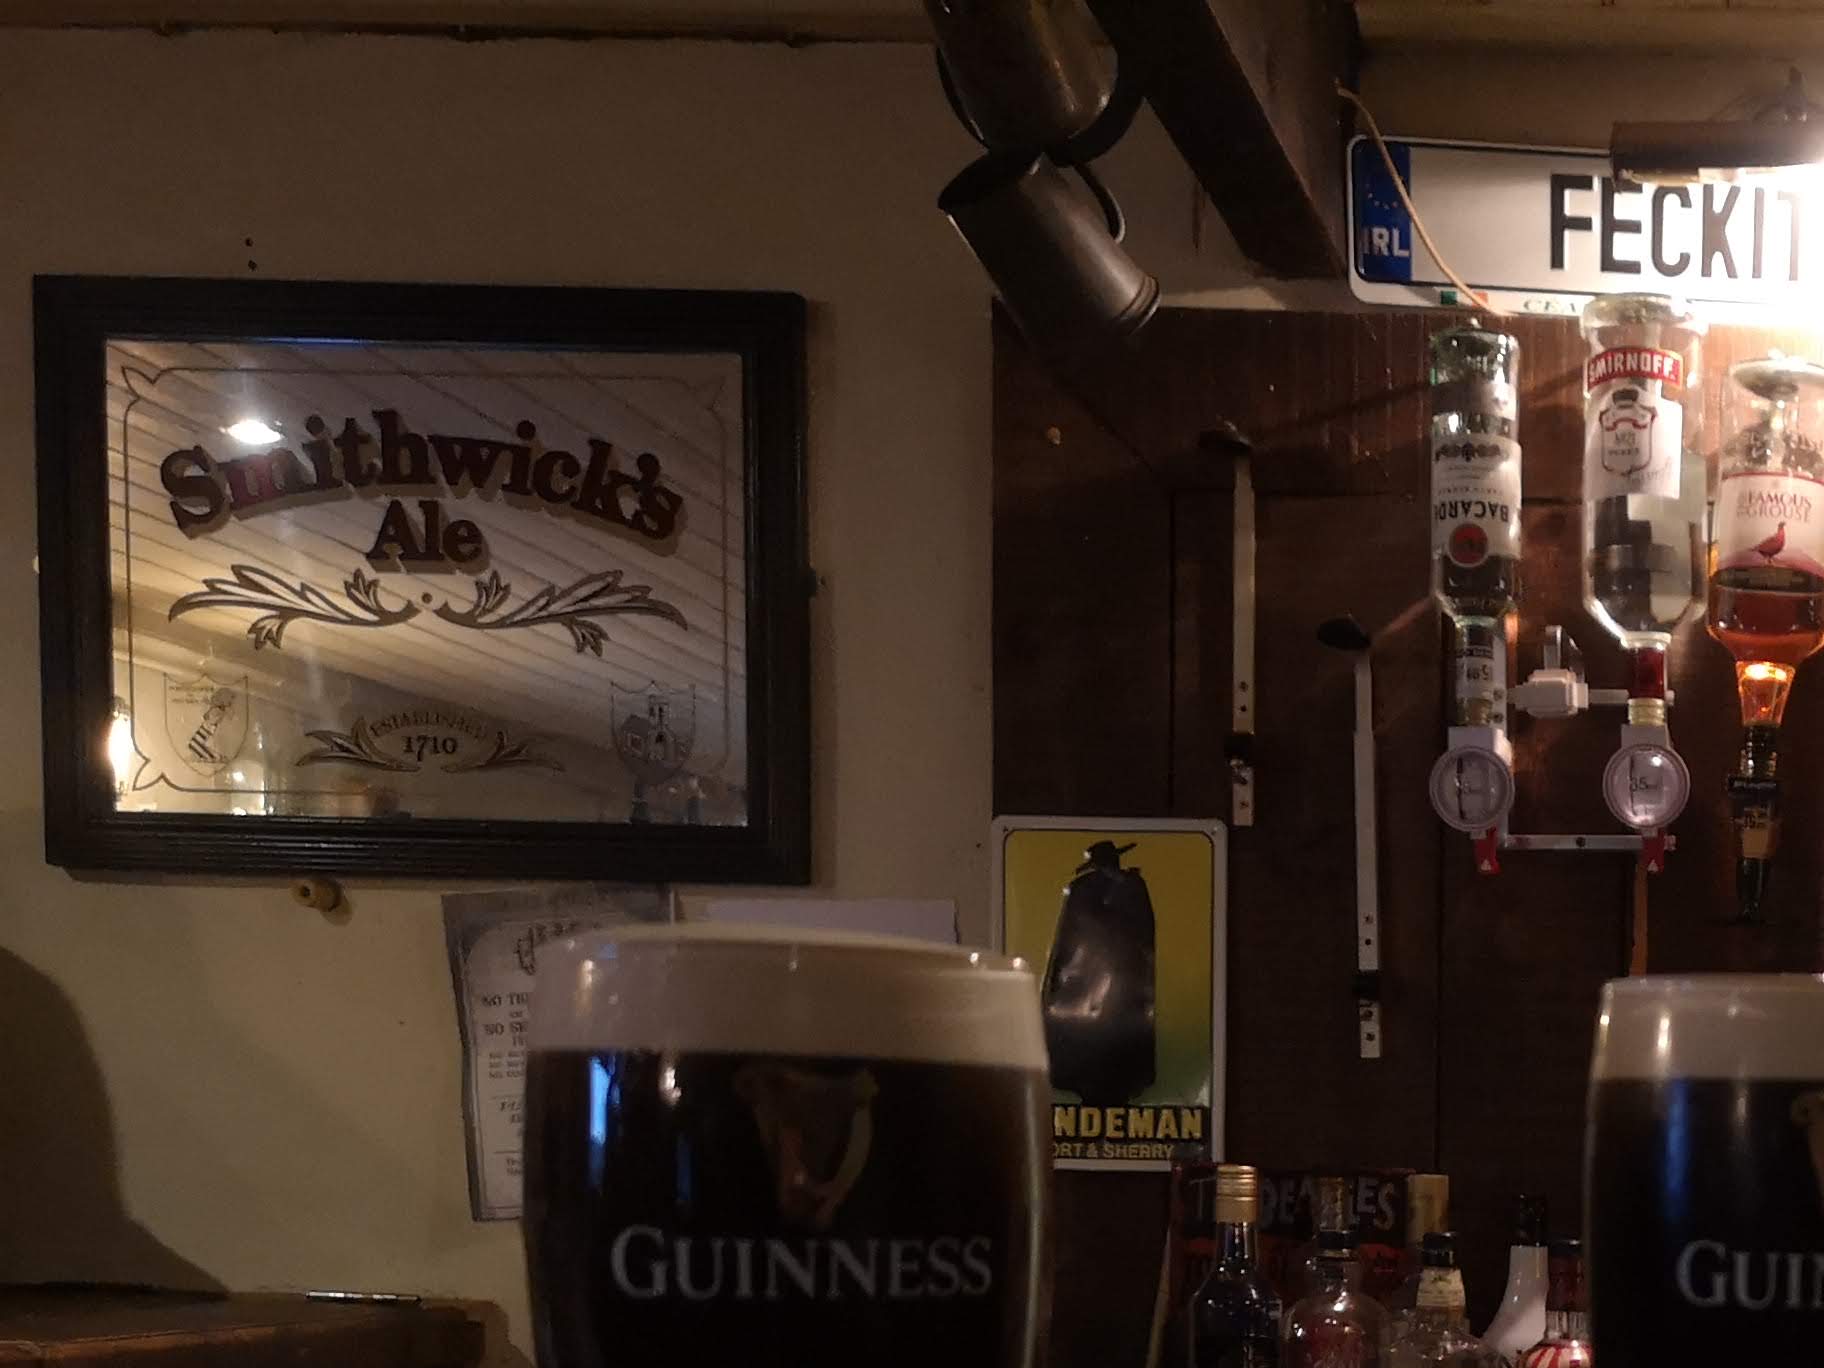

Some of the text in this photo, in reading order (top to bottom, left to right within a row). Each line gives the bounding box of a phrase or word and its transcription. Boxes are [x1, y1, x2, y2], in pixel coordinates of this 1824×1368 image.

[1362, 226, 1410, 258] IRL
[1588, 351, 1676, 383] SMIRNOFF
[160, 408, 685, 541] Smithwick's
[366, 499, 485, 567] Ale
[404, 735, 458, 762] 1710
[1053, 1104, 1204, 1140] NDEMAN
[1052, 1142, 1085, 1159] ORT
[1102, 1142, 1176, 1160] SHERRY
[610, 1222, 993, 1300] GUINNESS
